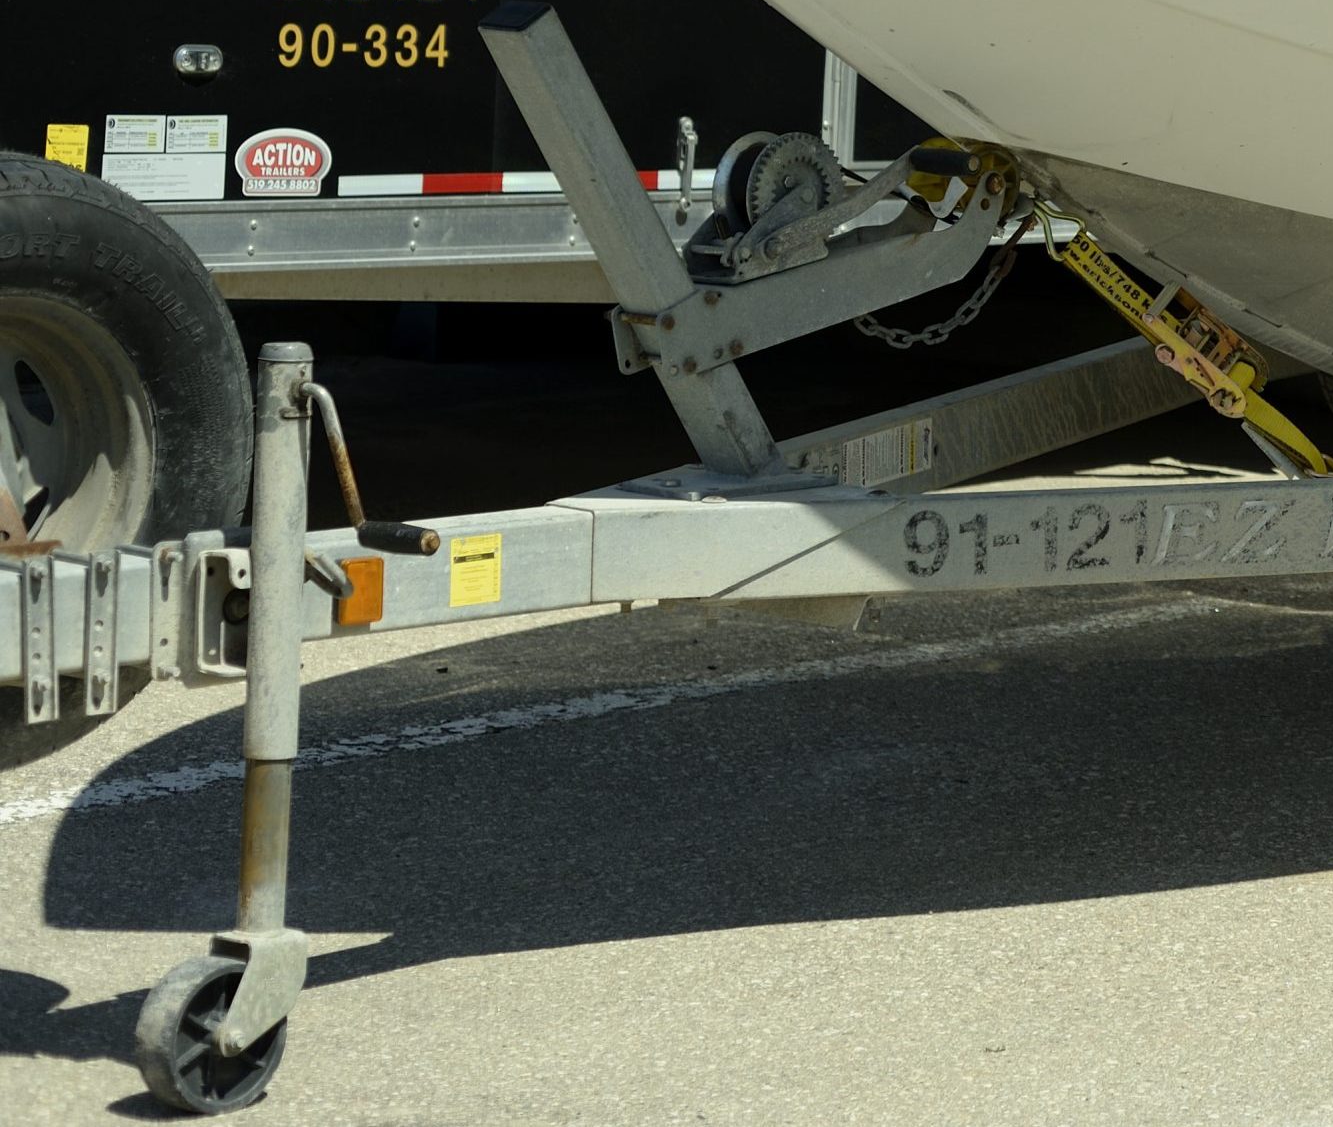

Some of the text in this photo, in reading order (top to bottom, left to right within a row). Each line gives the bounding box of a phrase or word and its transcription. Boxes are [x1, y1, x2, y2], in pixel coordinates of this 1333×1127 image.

[277, 22, 449, 68] 90-334
[252, 142, 317, 167] ACTION
[260, 167, 305, 177] TRAILERS
[247, 179, 316, 191] 519 245 8802
[903, 488, 1148, 577] 91-121
[1150, 487, 1298, 567] EZ
